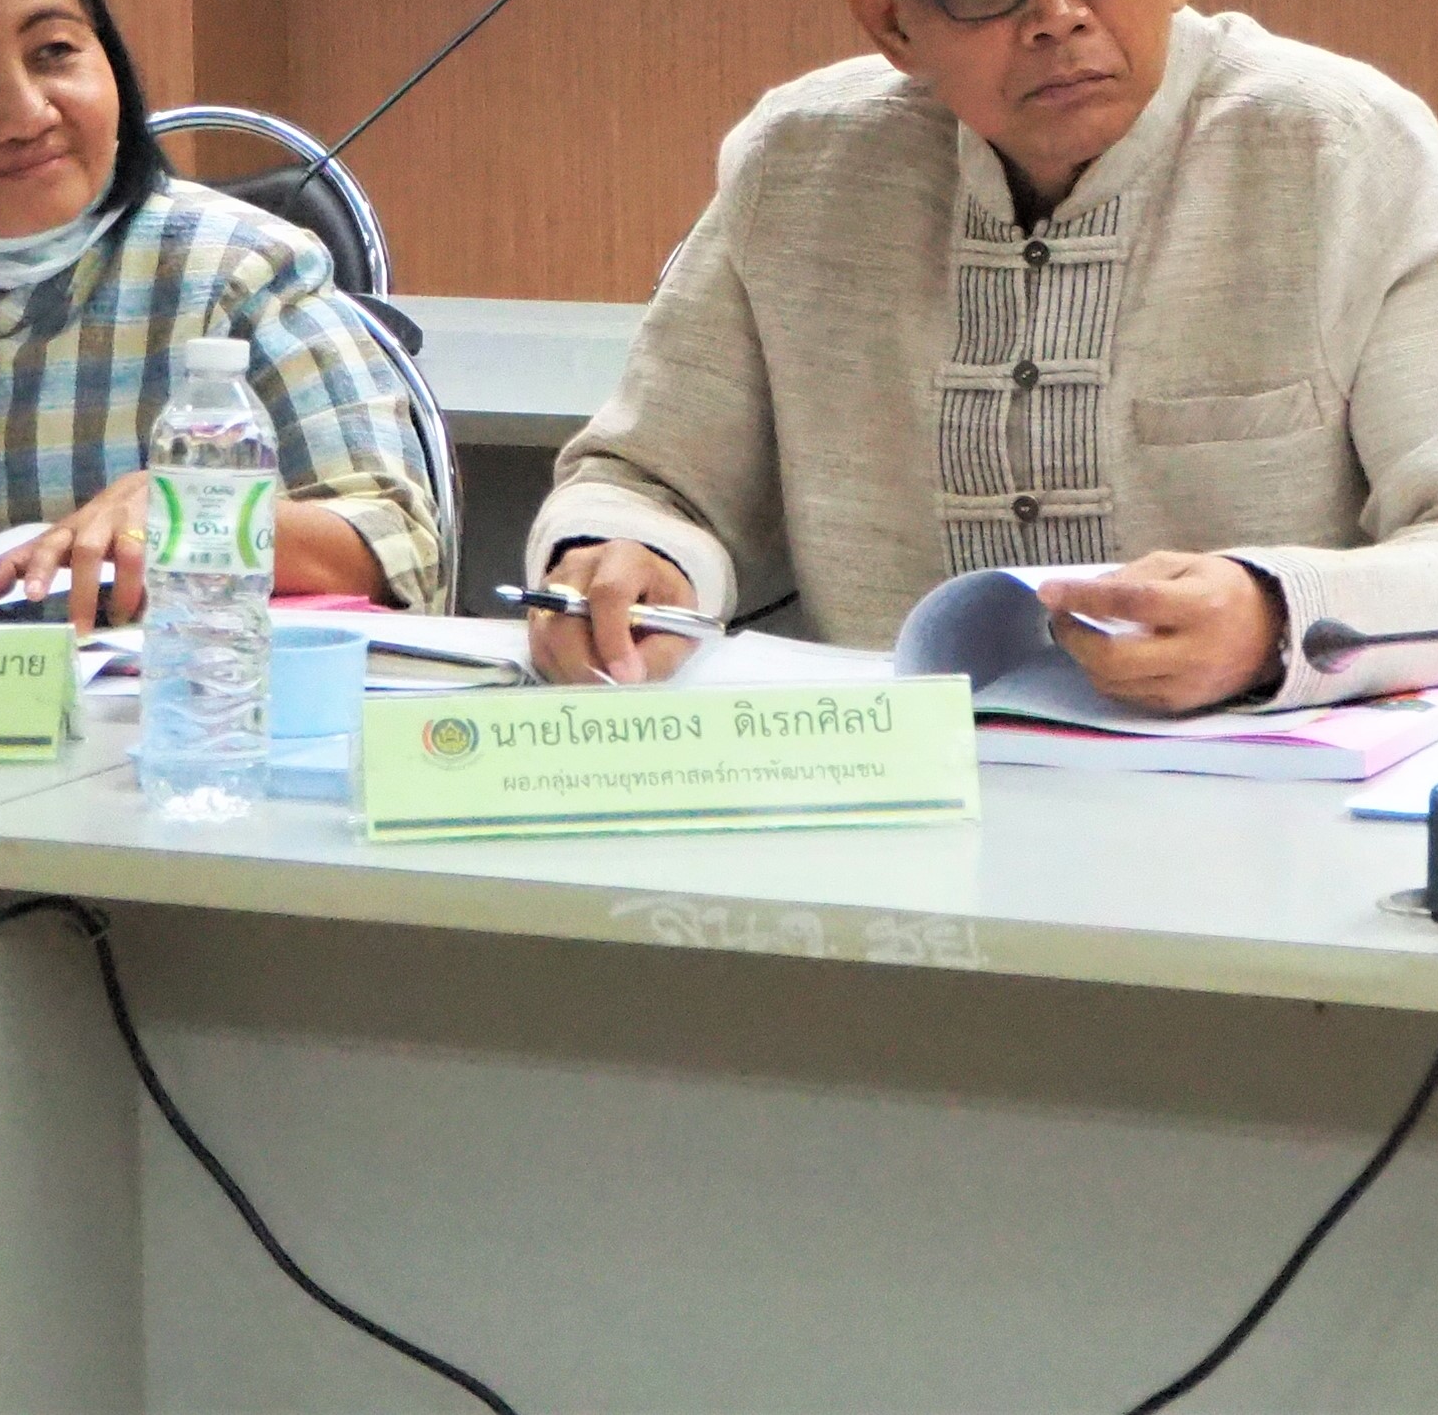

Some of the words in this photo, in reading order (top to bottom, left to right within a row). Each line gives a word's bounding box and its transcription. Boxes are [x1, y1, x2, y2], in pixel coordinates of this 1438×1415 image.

[491, 704, 703, 750] นายโดมทอง
[734, 692, 894, 740] ดิเรกศิลป์
[503, 759, 886, 796] ผอ.กลุ่มงานยุทธศาสตร์การพัฒนาชุมชน
